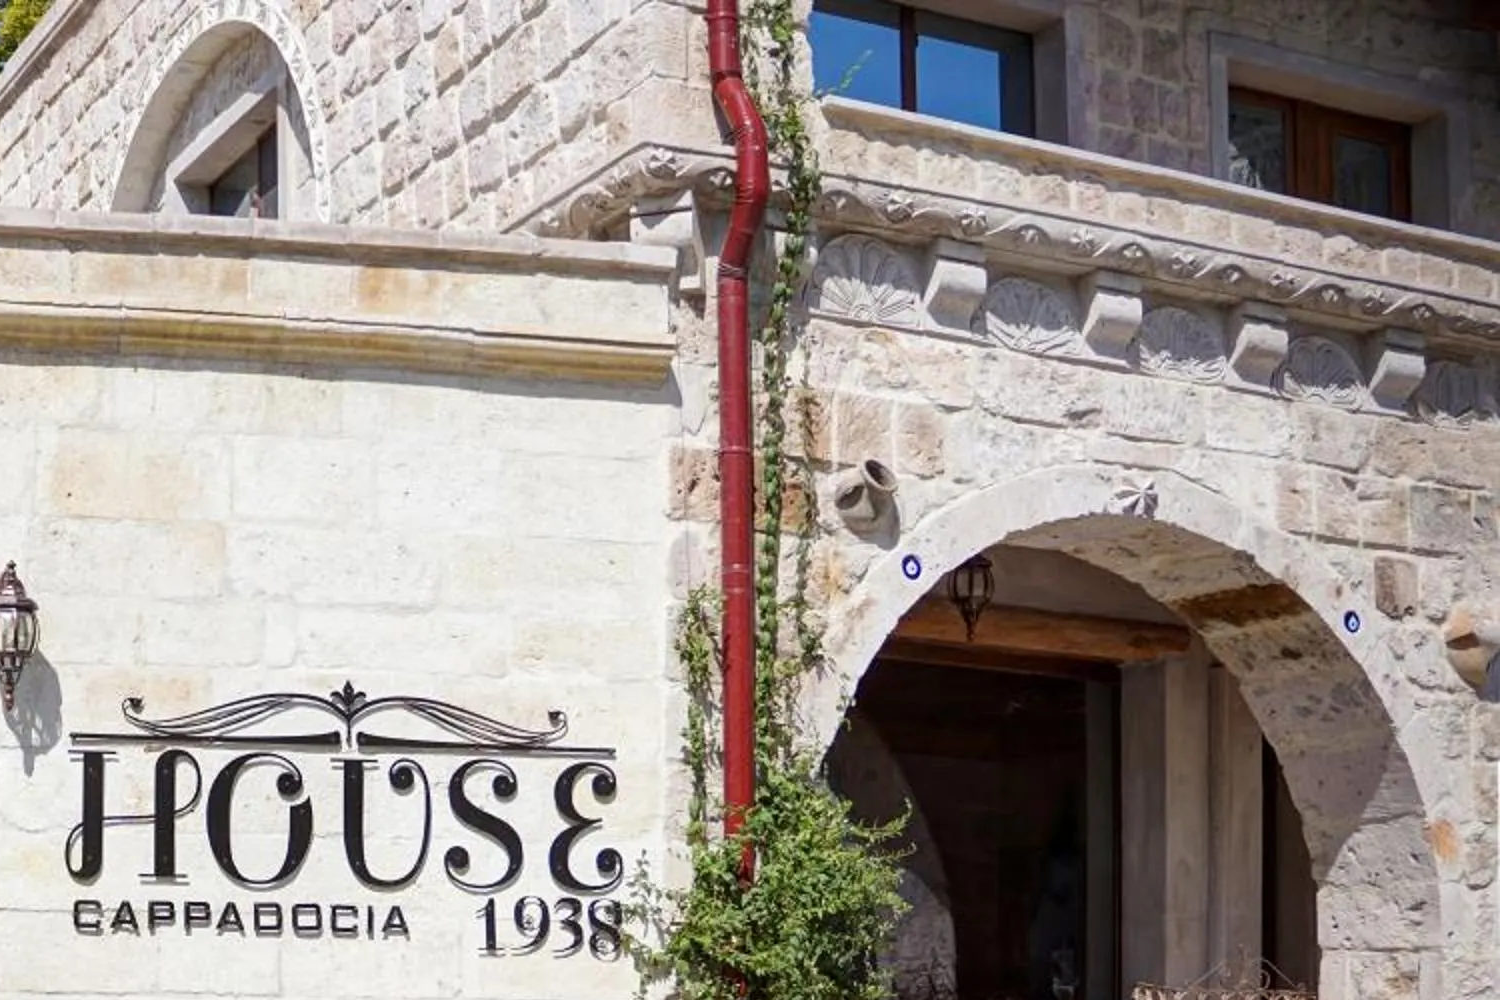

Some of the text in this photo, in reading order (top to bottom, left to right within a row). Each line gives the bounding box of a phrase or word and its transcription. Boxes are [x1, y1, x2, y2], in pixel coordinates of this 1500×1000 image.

[65, 749, 623, 891] HOUSE
[73, 899, 411, 939] CAPPADOCIA
[475, 895, 623, 962] 1938
